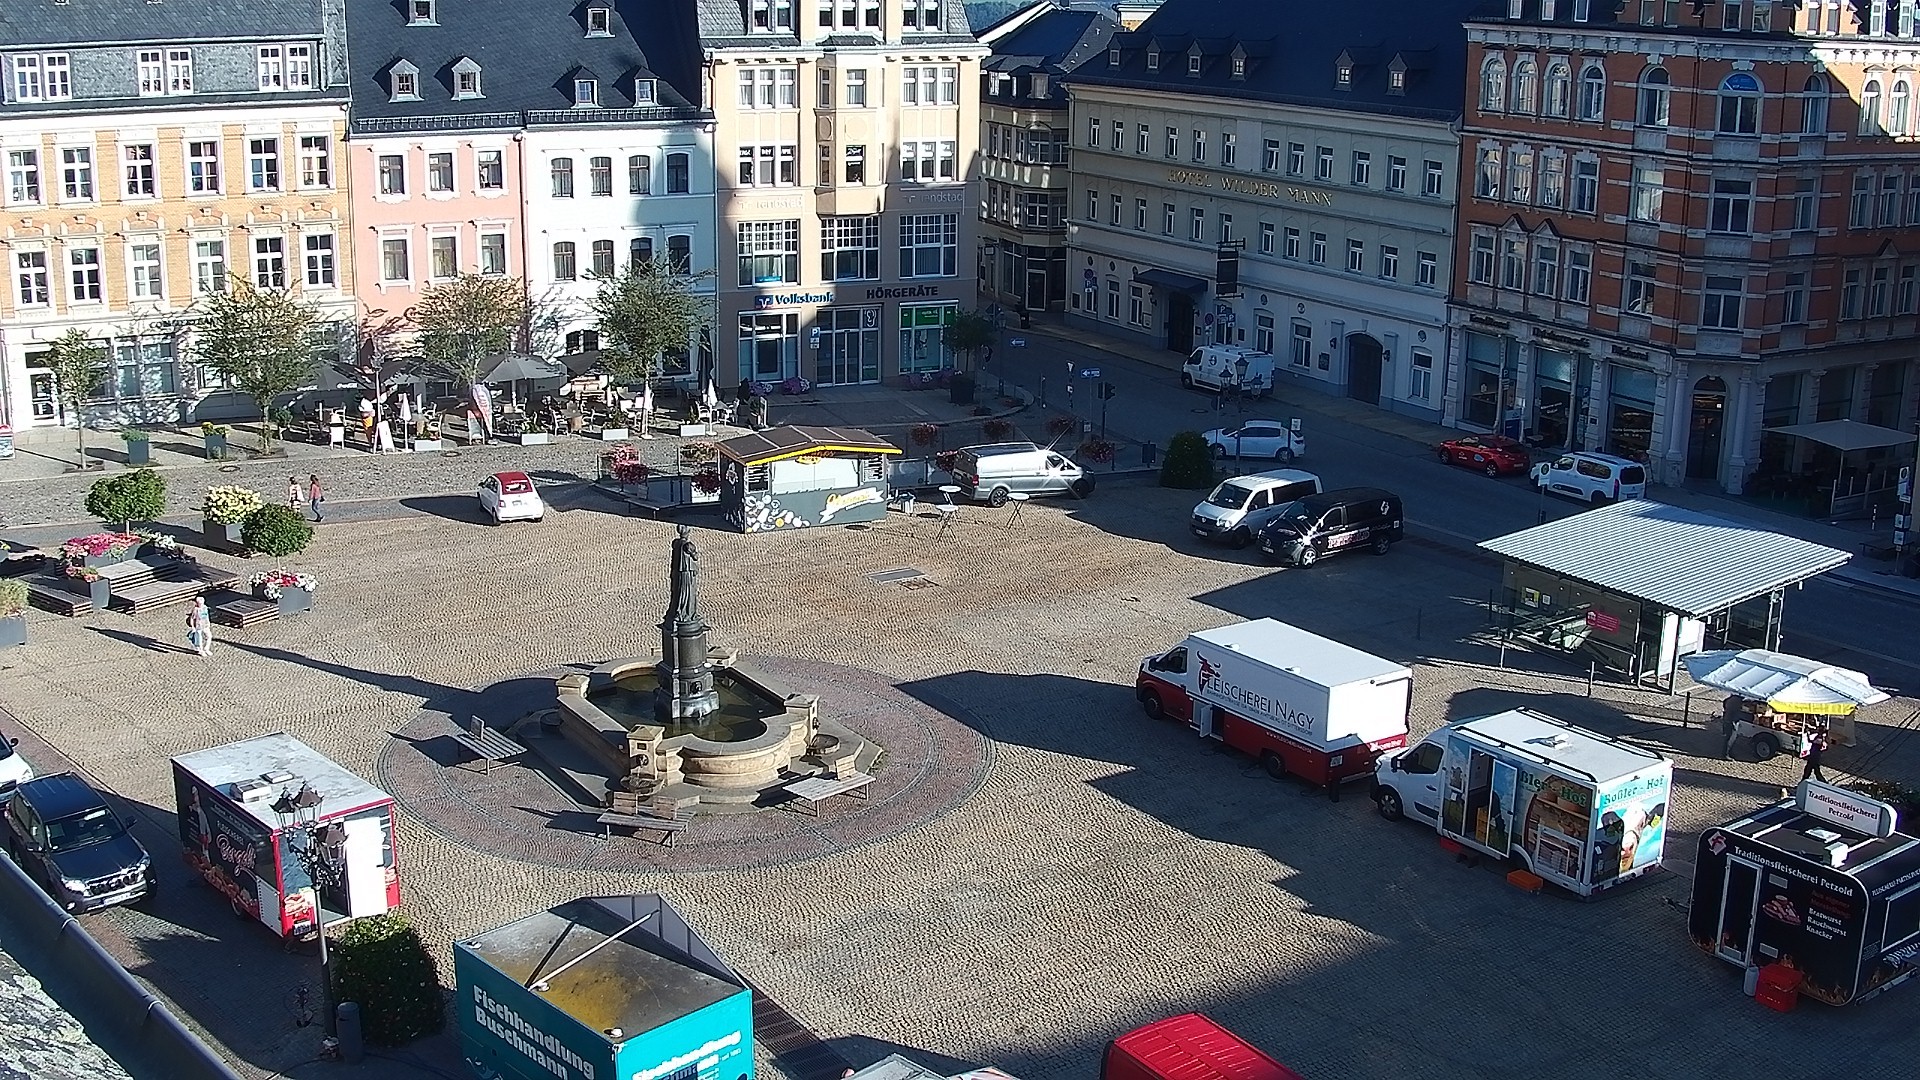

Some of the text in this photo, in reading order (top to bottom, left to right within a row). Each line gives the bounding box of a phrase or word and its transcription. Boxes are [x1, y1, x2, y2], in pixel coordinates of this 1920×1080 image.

[920, 192, 964, 203] randstad
[1168, 169, 1333, 207] HOTEL WILDER MANN
[775, 292, 834, 305] Volksbank
[866, 286, 939, 300] HÖRGERÄTE
[1201, 671, 1315, 730] FLEISCHEREI NAGY
[1519, 771, 1549, 791] ßler
[1808, 790, 1878, 820] Traditionsfleischerei
[1828, 807, 1854, 822] Petzold
[1734, 845, 1853, 897] Traditionsfleischerei Petzold
[473, 984, 595, 1080] Fischhandlung
[475, 1005, 569, 1080] Buschmann
